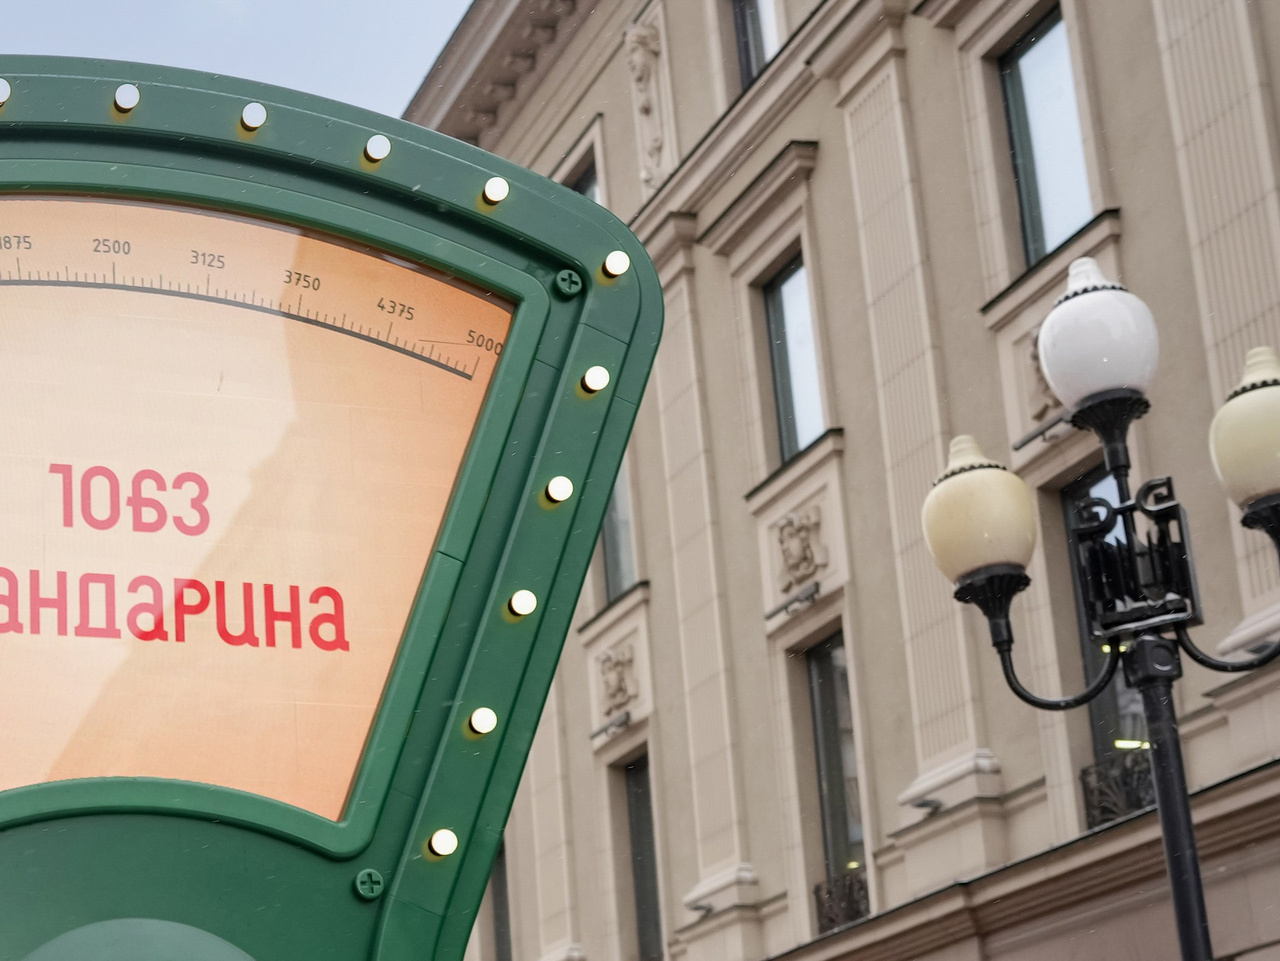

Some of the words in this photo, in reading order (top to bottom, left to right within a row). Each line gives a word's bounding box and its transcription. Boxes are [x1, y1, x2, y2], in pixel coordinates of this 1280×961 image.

[93, 239, 131, 255] 2500
[190, 250, 225, 269] 3125
[283, 270, 320, 291] 3750
[377, 297, 415, 321] 4375
[466, 329, 503, 356] 5000
[49, 463, 210, 536] 1063
